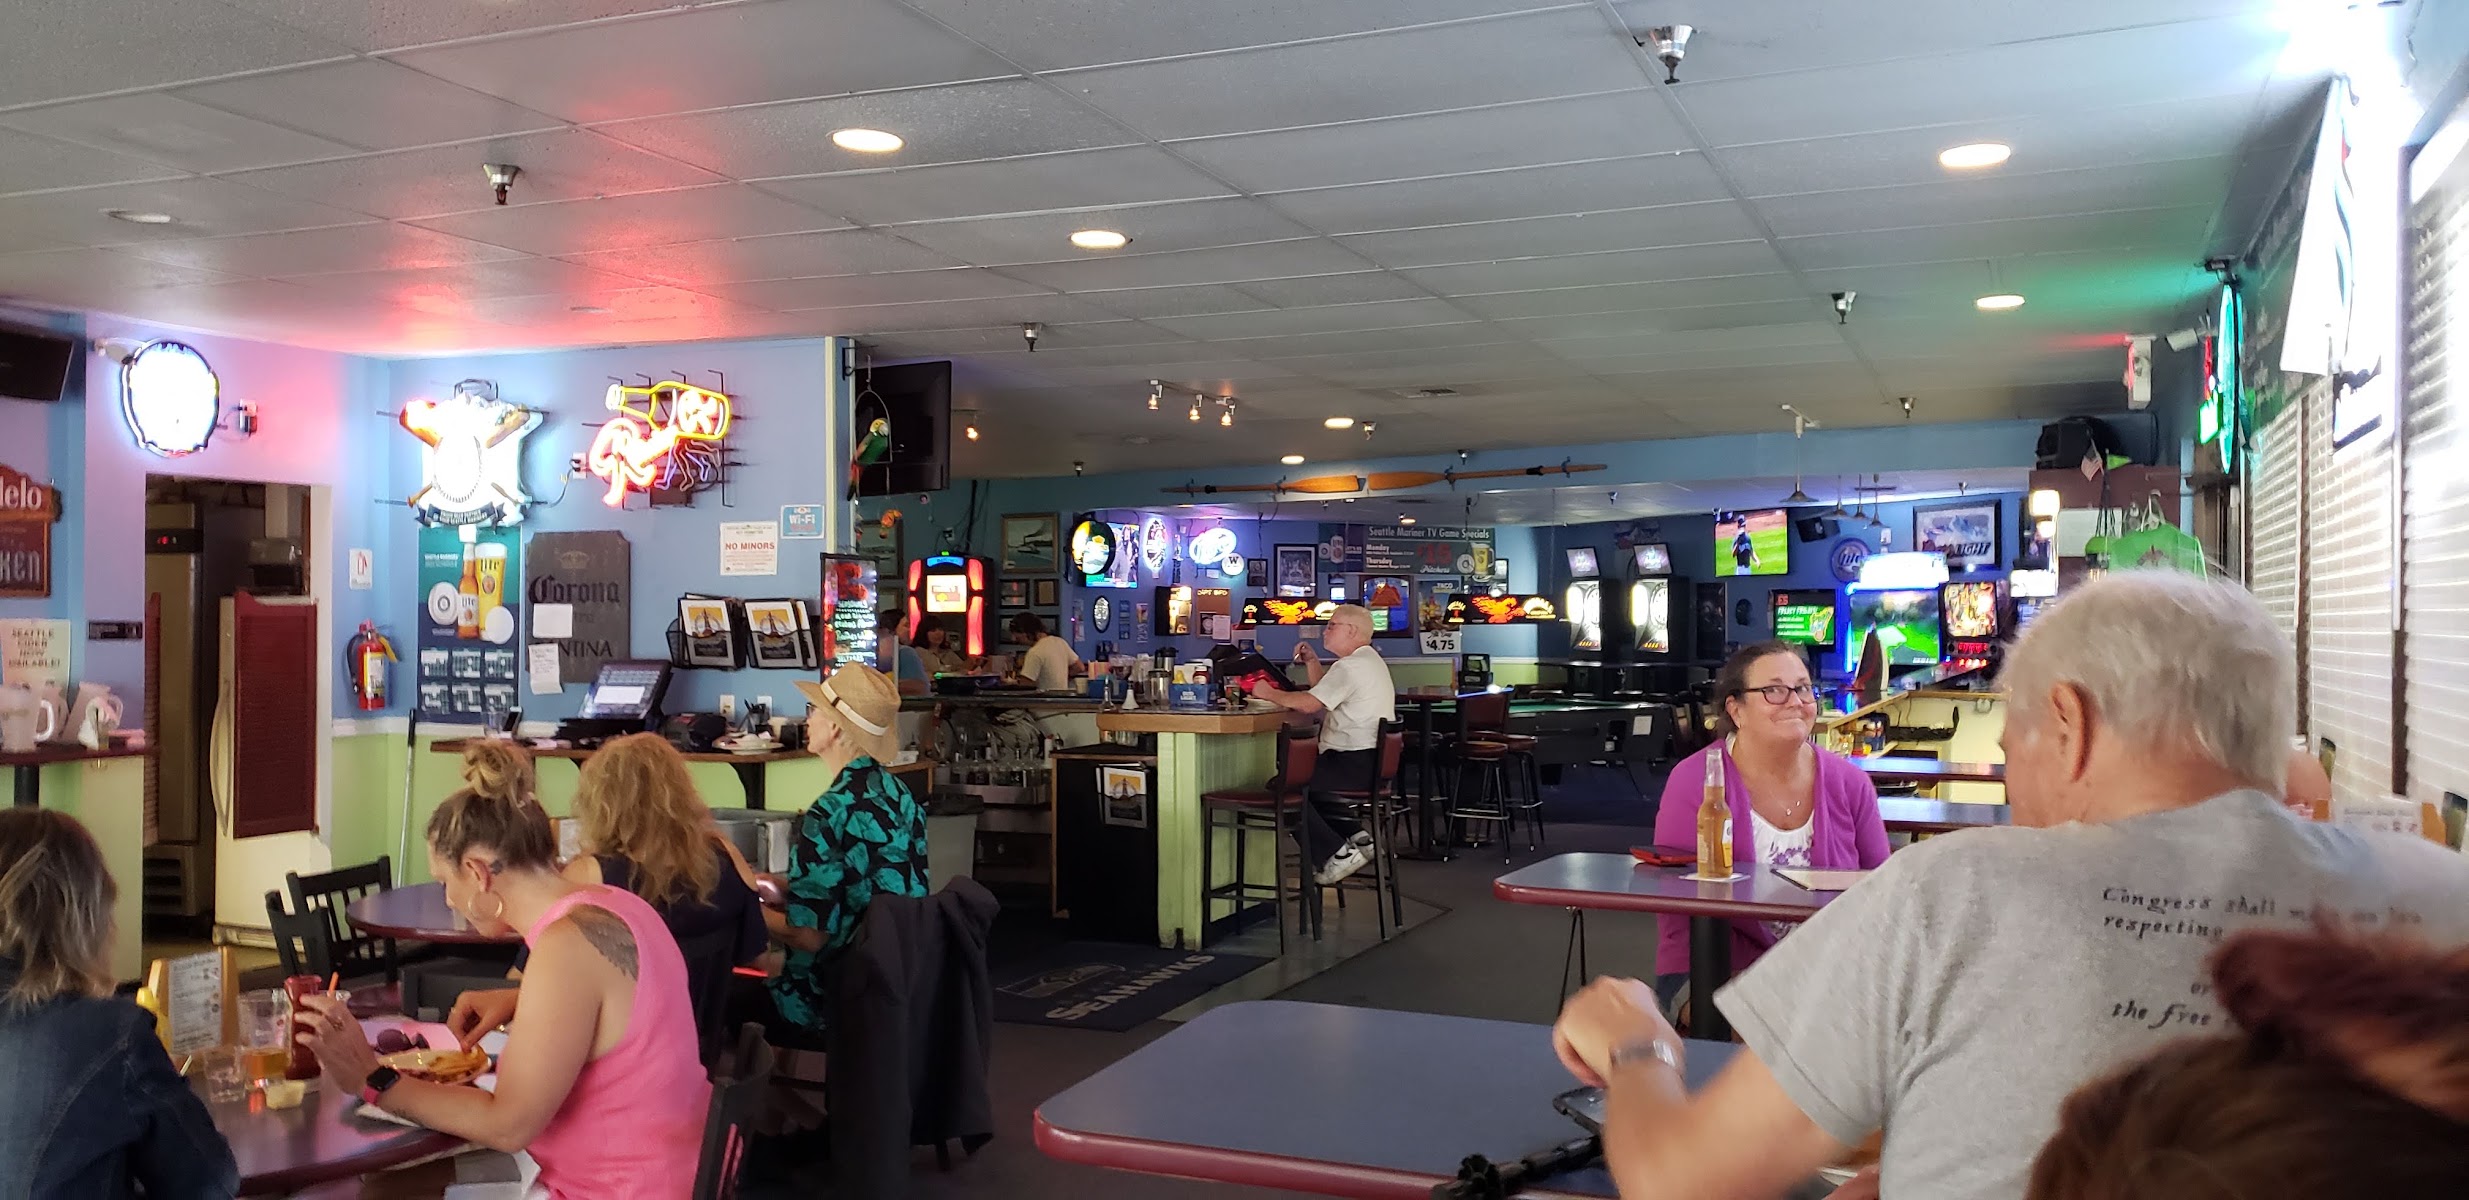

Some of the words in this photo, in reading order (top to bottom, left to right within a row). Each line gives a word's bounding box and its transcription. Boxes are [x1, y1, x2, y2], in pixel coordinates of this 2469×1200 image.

[789, 514, 816, 525] Wi-Fi
[1369, 526, 1395, 537] Seattle
[1397, 527, 1425, 537] Mariner
[1427, 528, 1438, 537] TV
[1439, 528, 1460, 538] Game
[1462, 528, 1490, 539] Specials
[725, 543, 738, 551] NO
[740, 542, 776, 551] MINORS
[1366, 544, 1389, 553] Monday
[1955, 542, 1991, 556] LIGHT
[1228, 556, 1239, 565] W
[1366, 557, 1392, 567] Thursday
[1420, 565, 1450, 574] Pitchers
[528, 574, 621, 604] Corona
[12, 628, 55, 638] SEATTLE
[17, 639, 47, 649] CIDER
[557, 639, 613, 658] NTINA
[1426, 639, 1455, 651] $4.75
[20, 649, 45, 658] NOW
[2103, 887, 2211, 914] Congress
[2225, 895, 2276, 916] shall
[2103, 916, 2225, 943] respecting
[1045, 954, 1216, 1021] SEAHAWKS
[2112, 1000, 2149, 1021] the
[2147, 1003, 2212, 1031] free
